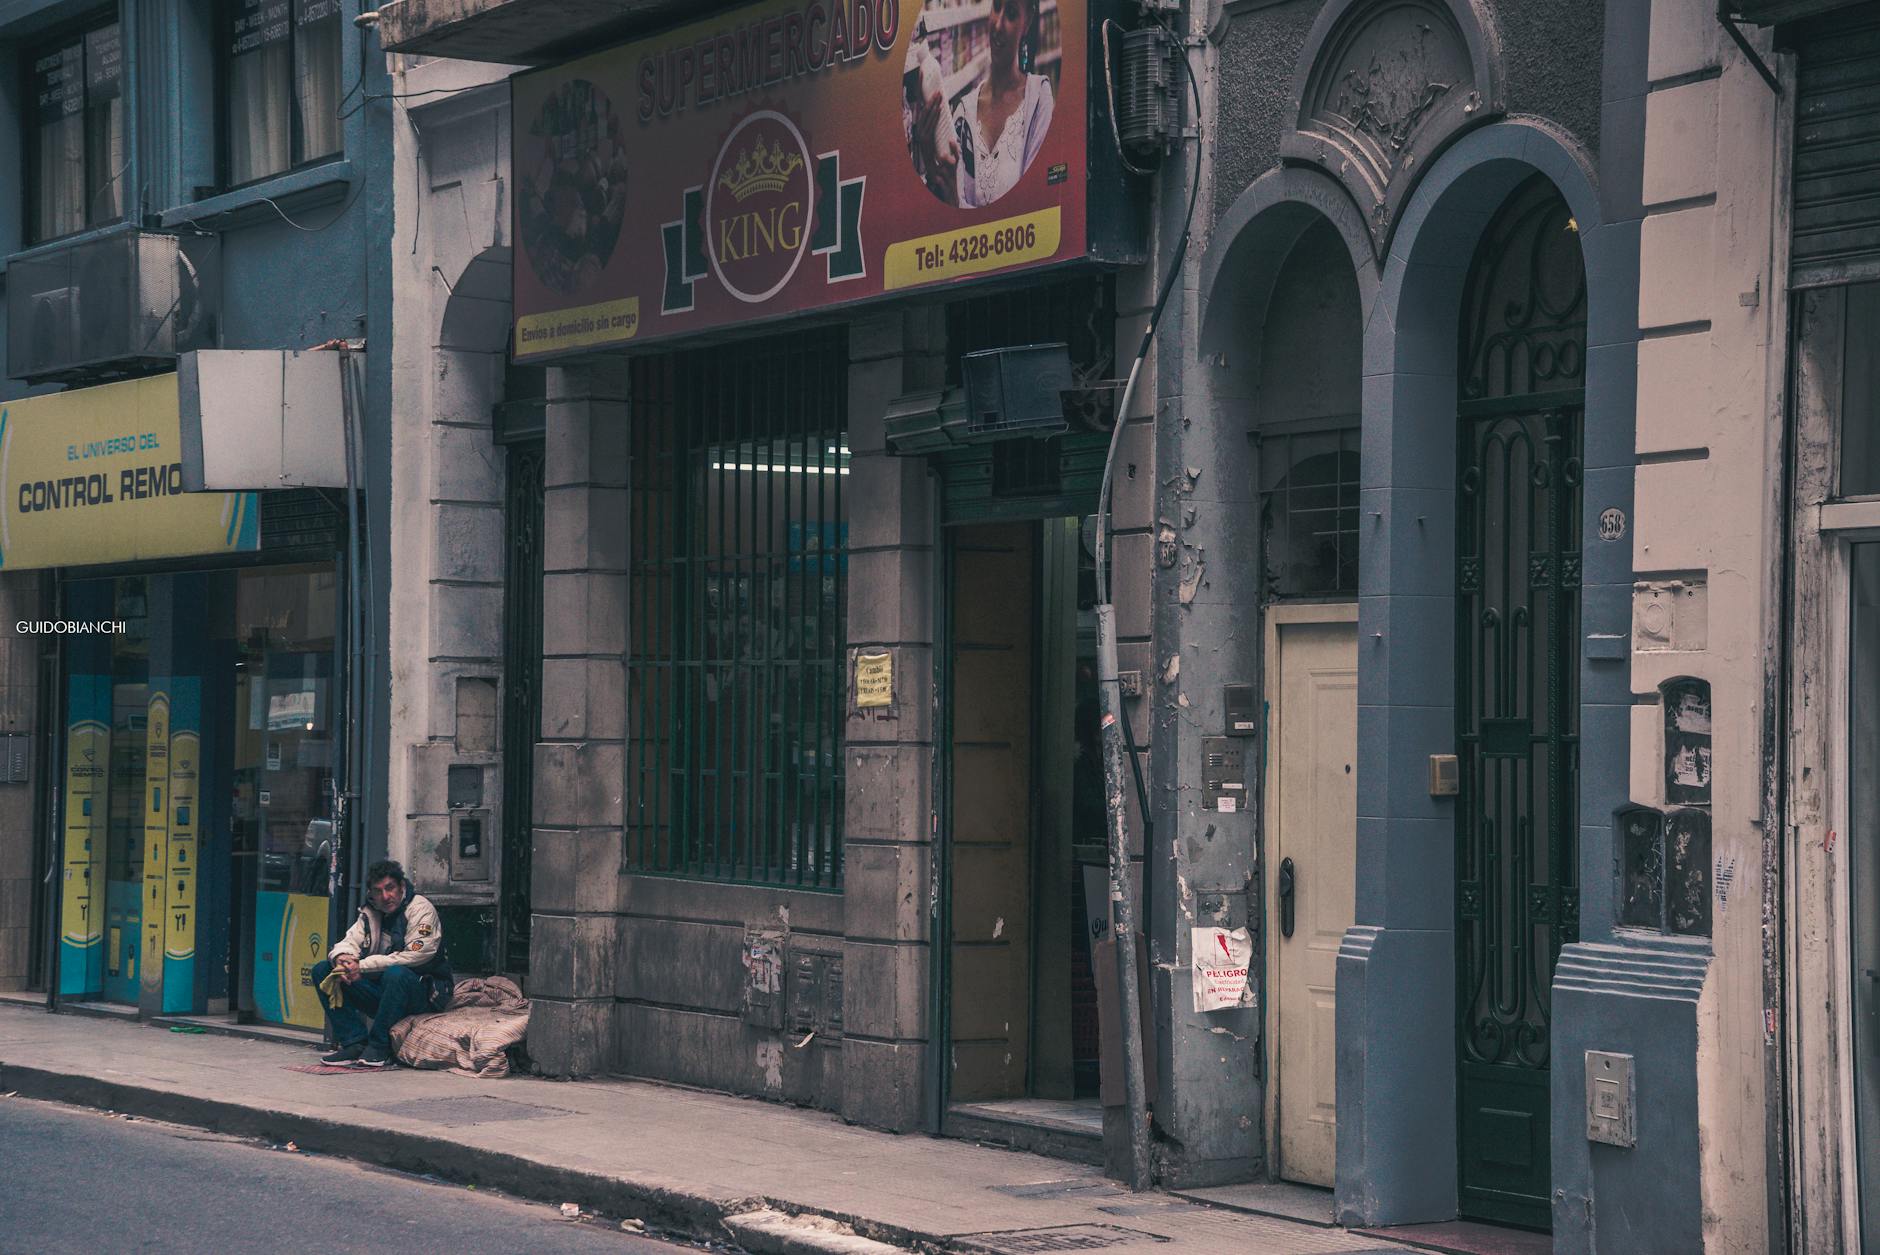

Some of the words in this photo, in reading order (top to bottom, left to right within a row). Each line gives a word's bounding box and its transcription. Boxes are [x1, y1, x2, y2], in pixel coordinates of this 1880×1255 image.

[638, 0, 900, 121] SUPERMERCADO
[720, 201, 801, 264] KING
[915, 244, 944, 271] Tel:
[948, 222, 1036, 264] 4328-6806
[597, 314, 609, 330] sin
[611, 311, 637, 329] cargo
[67, 445, 79, 461] EL
[83, 434, 136, 460] UNIVERSO
[139, 432, 160, 451] DEL
[19, 473, 113, 513] CONTROL
[1602, 513, 1621, 534] 658
[1207, 969, 1247, 978] PELIGRO
